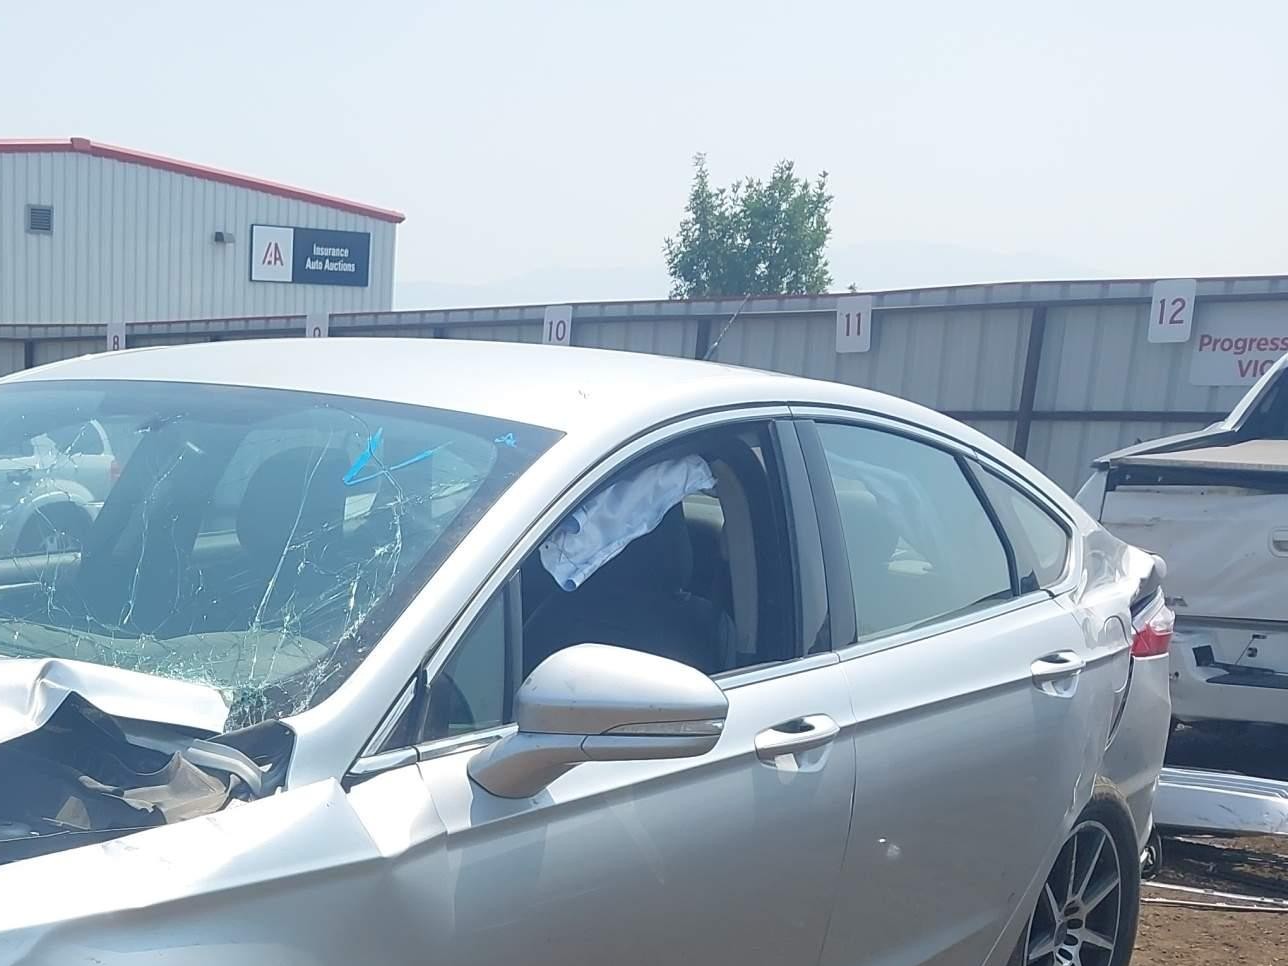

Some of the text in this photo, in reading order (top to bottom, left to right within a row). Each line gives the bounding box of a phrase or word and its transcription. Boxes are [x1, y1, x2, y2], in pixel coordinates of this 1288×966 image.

[313, 243, 349, 257] Insurance
[305, 257, 355, 272] Auto Auctions
[1158, 298, 1186, 325] 12
[548, 320, 566, 341] 10
[845, 311, 862, 337] 11
[112, 335, 120, 351] 8
[1199, 334, 1288, 355] Progress
